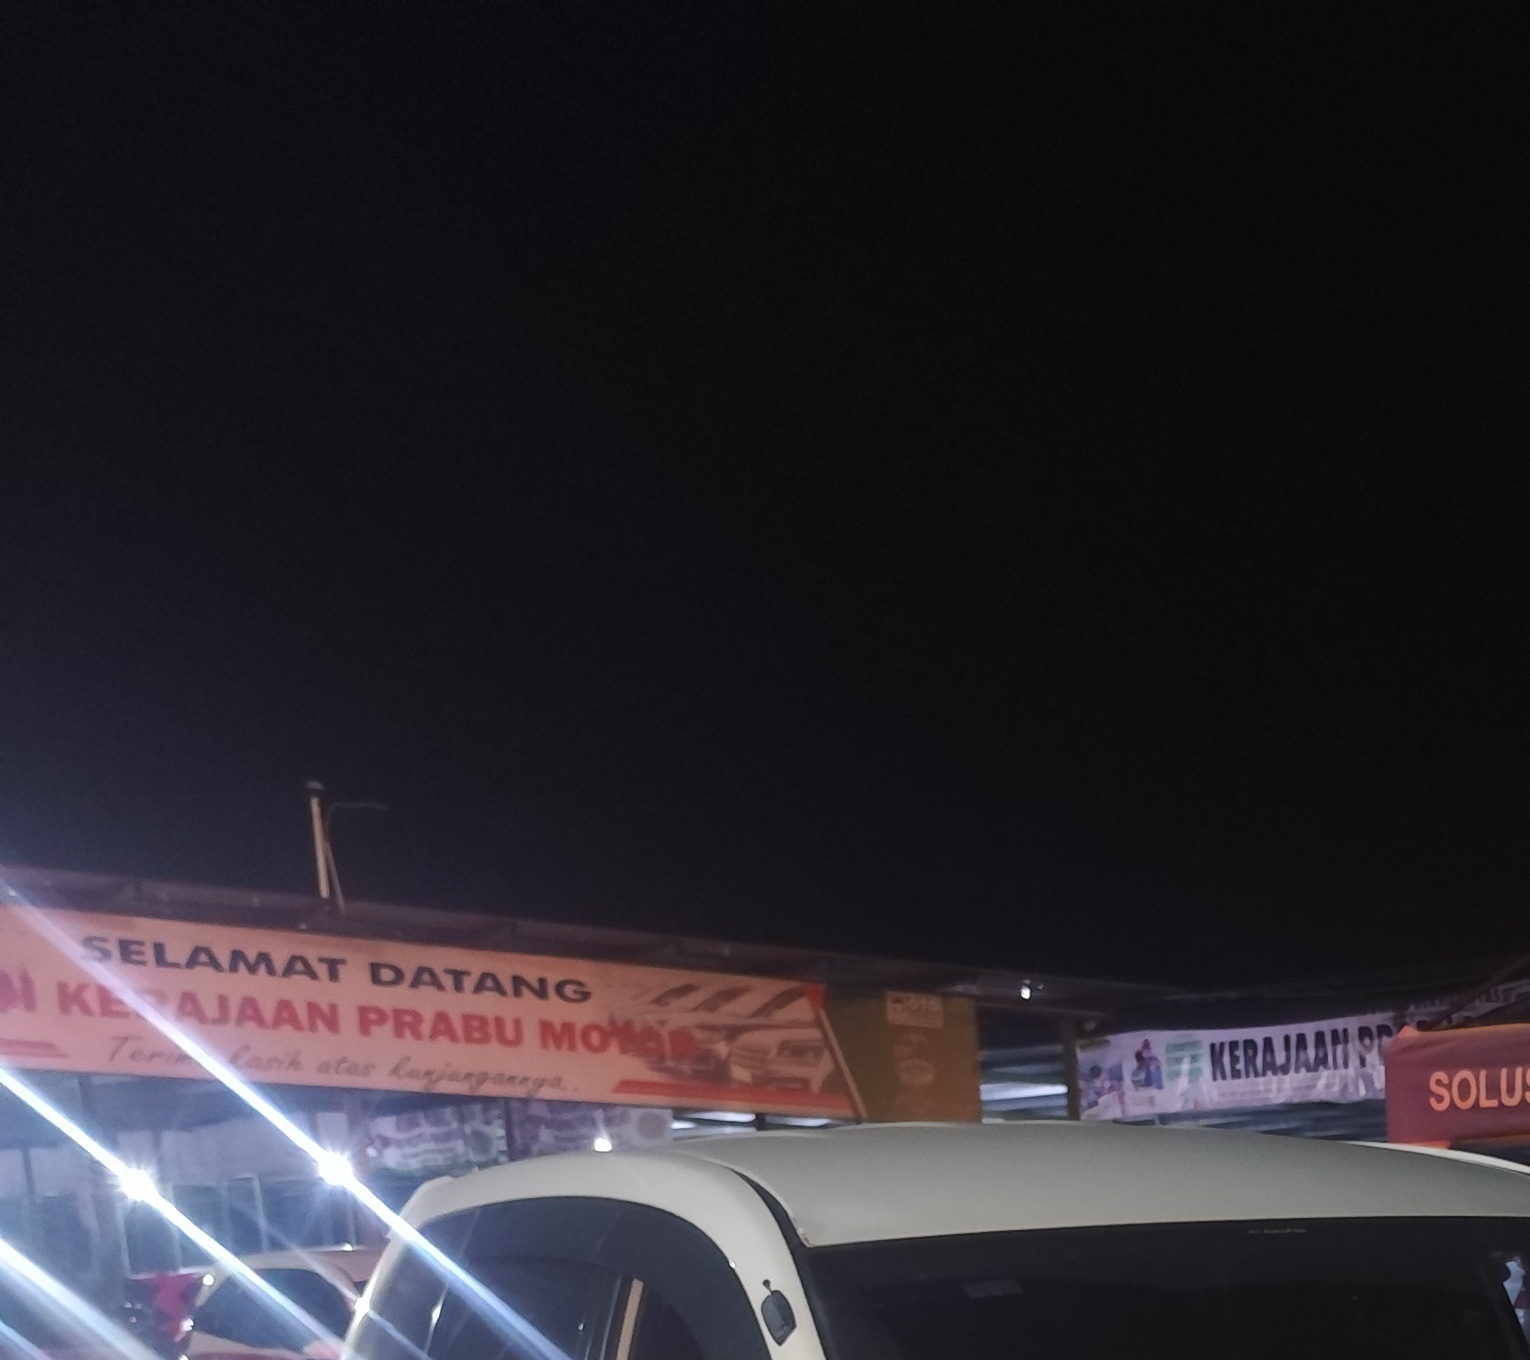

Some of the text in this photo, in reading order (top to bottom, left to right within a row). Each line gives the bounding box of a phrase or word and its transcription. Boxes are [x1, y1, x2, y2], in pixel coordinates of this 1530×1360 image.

[81, 935, 591, 1003] SELAMAT DATANG
[357, 1005, 524, 1048] PRABU
[1209, 1027, 1349, 1082] KERAJAAN
